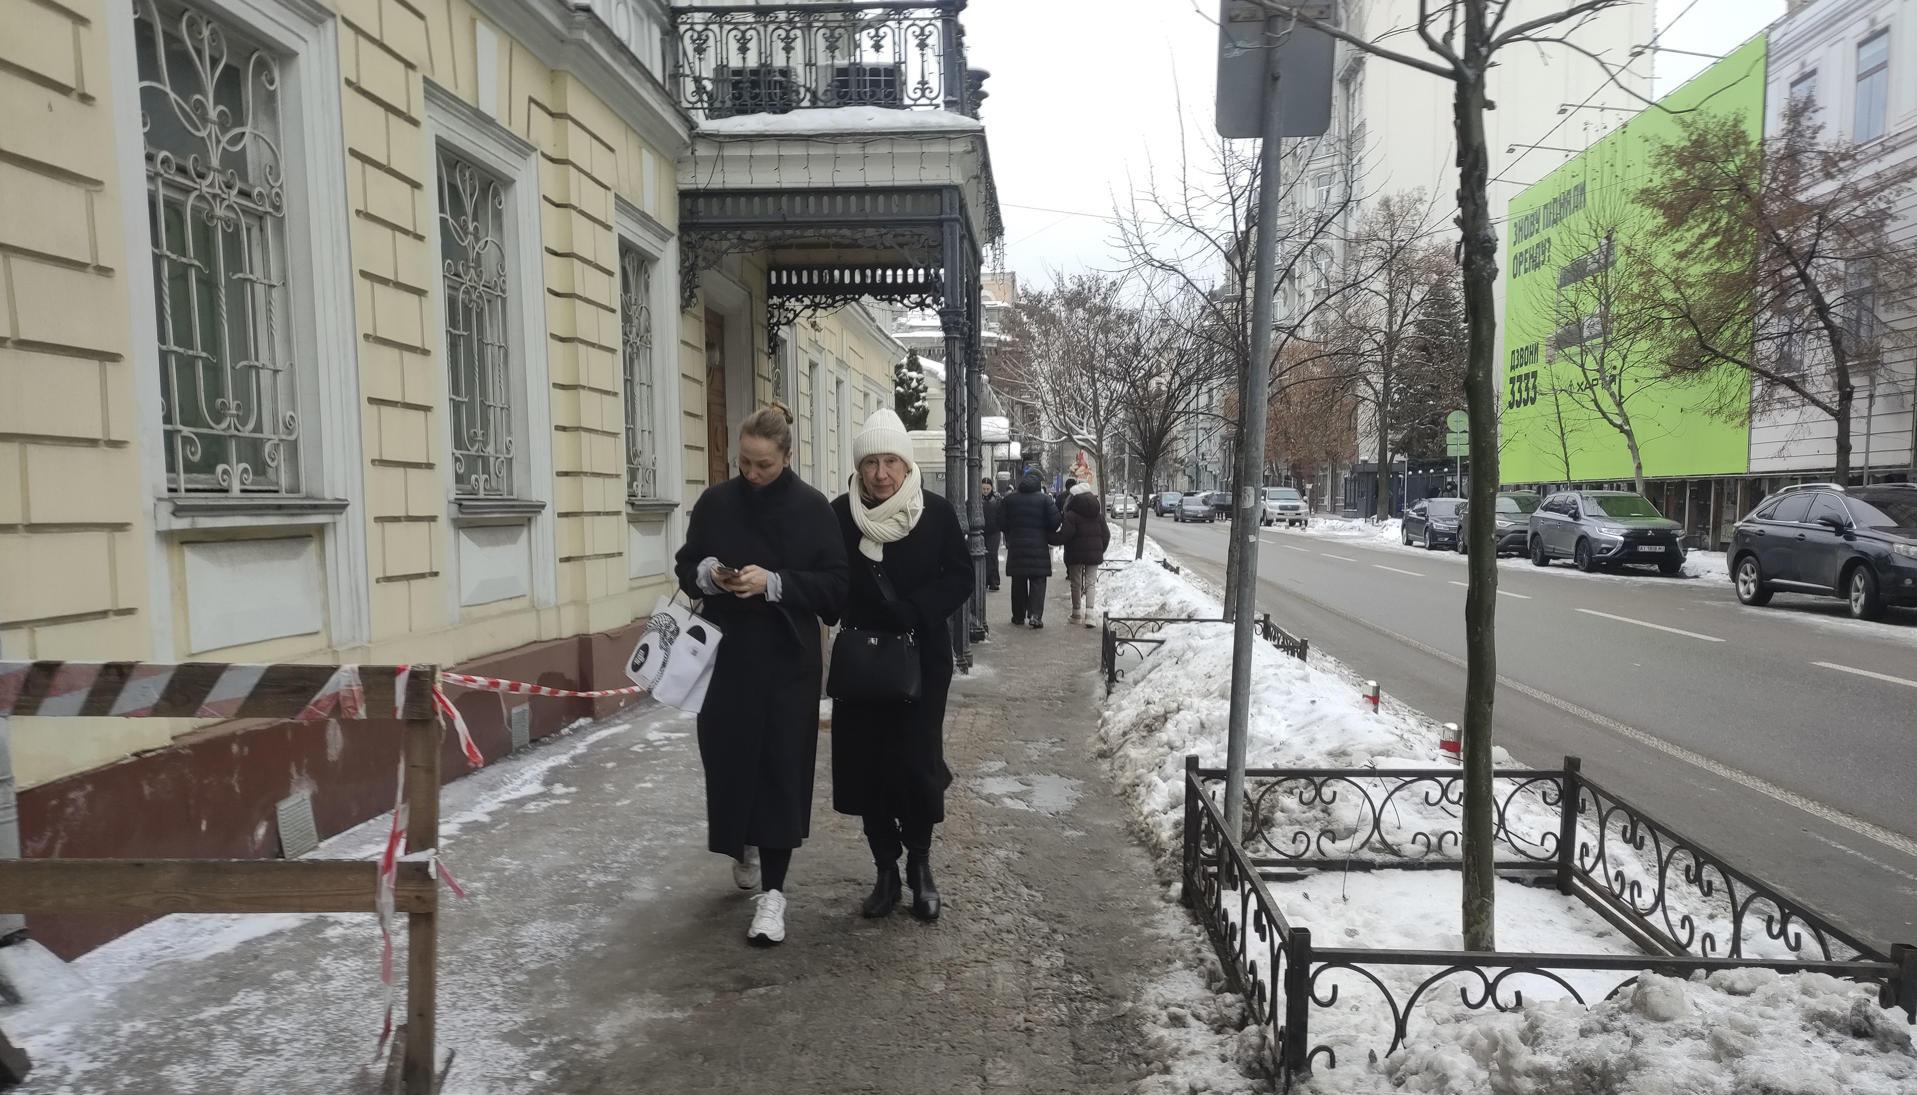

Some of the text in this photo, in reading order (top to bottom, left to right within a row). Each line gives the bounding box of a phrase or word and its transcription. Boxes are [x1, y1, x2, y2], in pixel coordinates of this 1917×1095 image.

[1513, 207, 1540, 247] ЗНОВУ
[1512, 236, 1552, 279] ОРЕНДУ?
[1510, 342, 1539, 372] ДЗВОНИ
[1508, 370, 1538, 409] 3333
